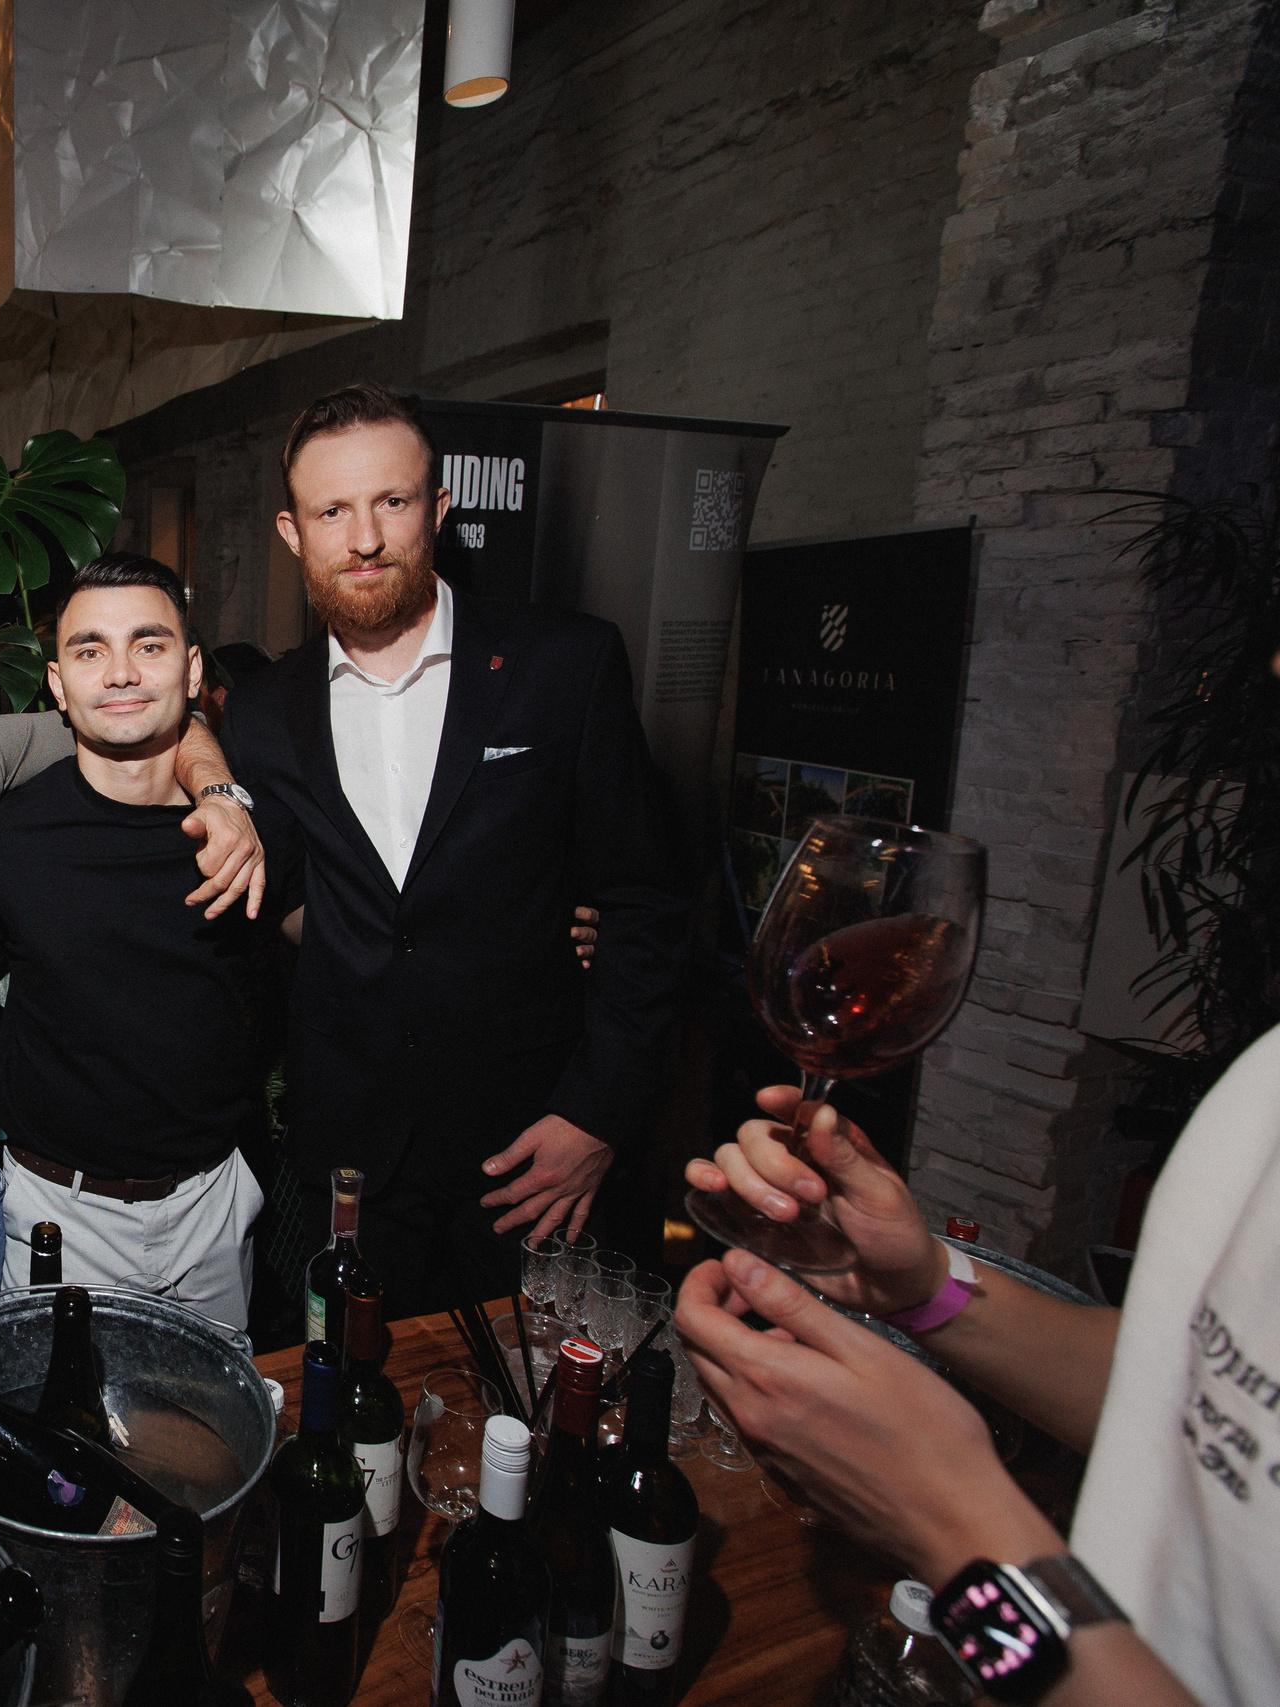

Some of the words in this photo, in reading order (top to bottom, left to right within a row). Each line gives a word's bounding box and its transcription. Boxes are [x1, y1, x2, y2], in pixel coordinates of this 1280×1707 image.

[442, 454, 525, 511] UDING
[455, 522, 486, 549] 1993
[331, 1532, 360, 1573] G7
